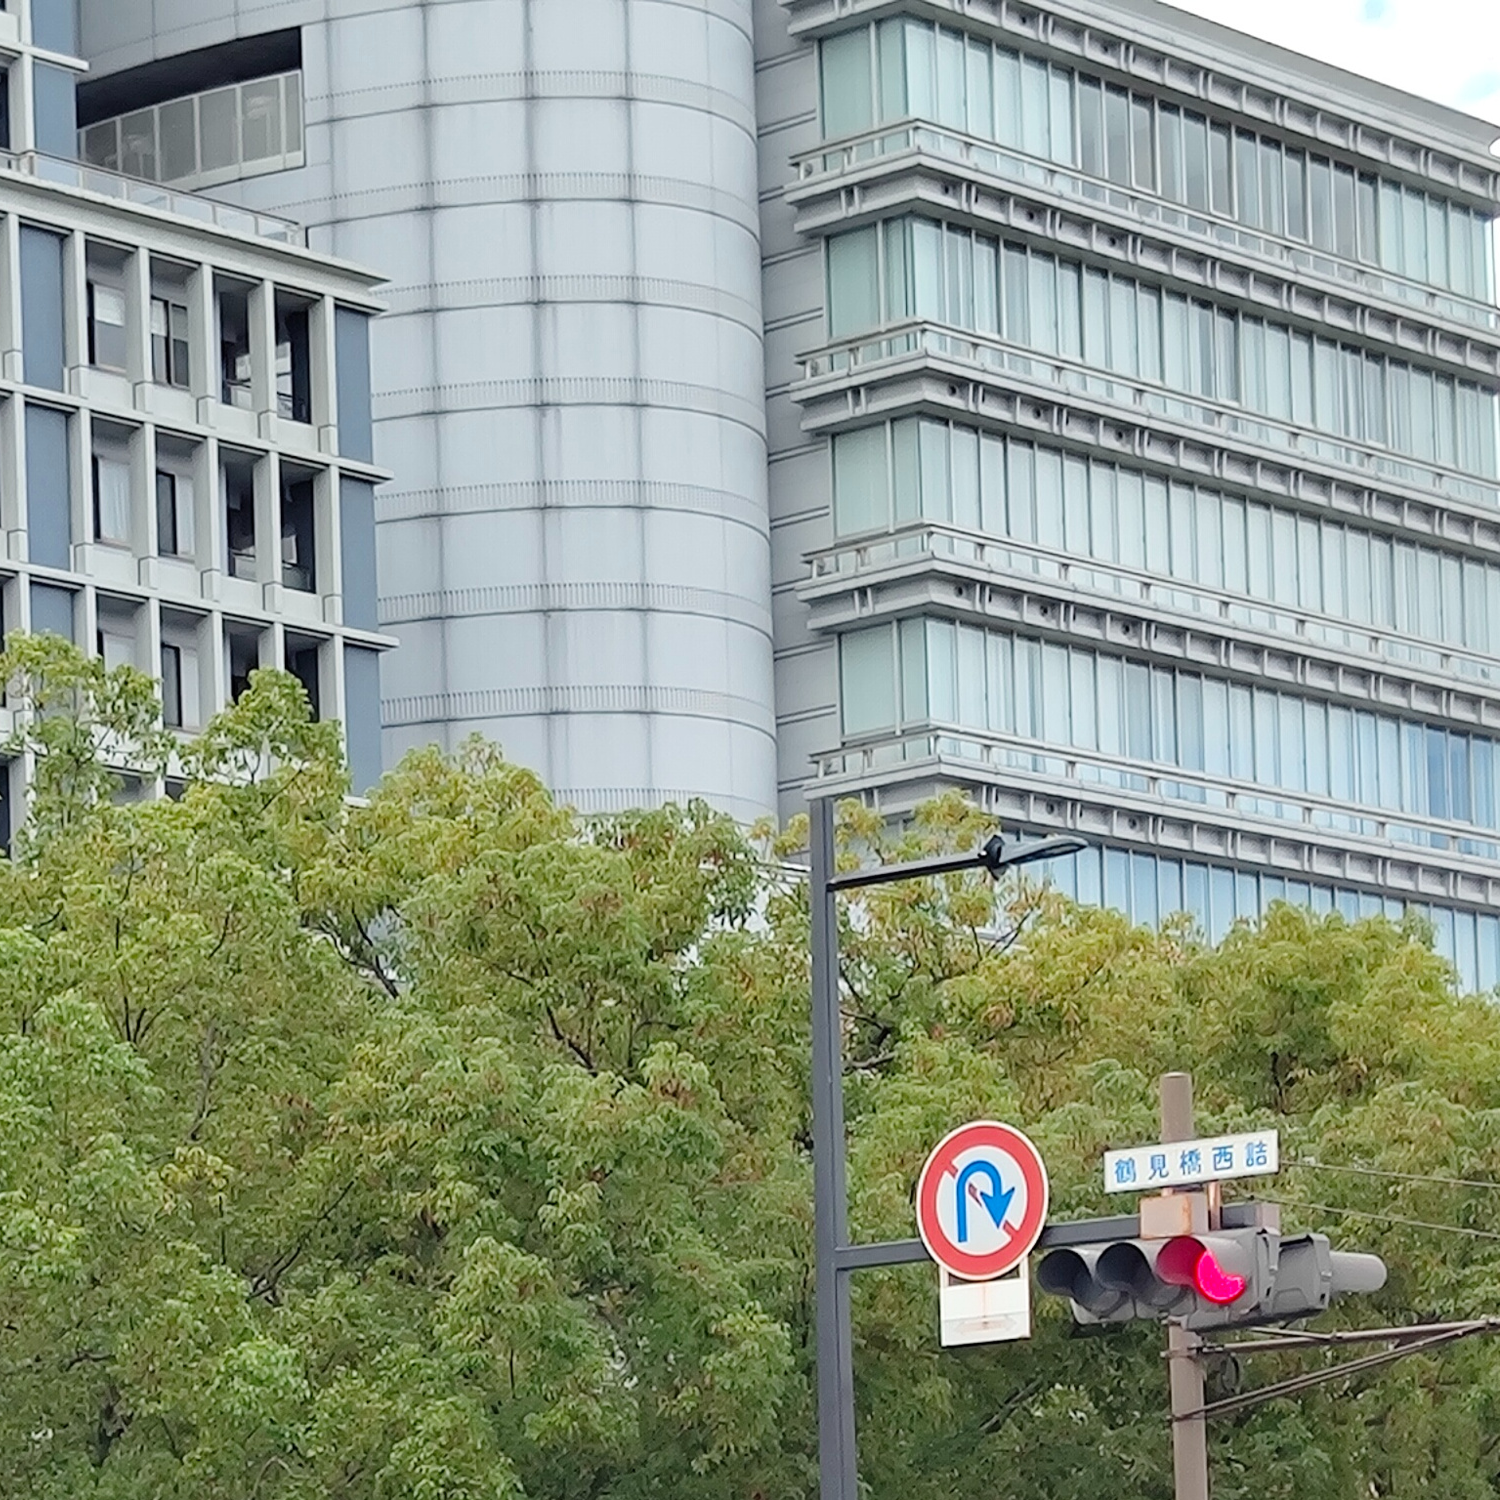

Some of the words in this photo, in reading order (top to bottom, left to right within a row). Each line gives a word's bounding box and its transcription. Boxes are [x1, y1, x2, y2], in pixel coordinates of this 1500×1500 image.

[1114, 1139, 1268, 1184] 鶴見橋西詰
